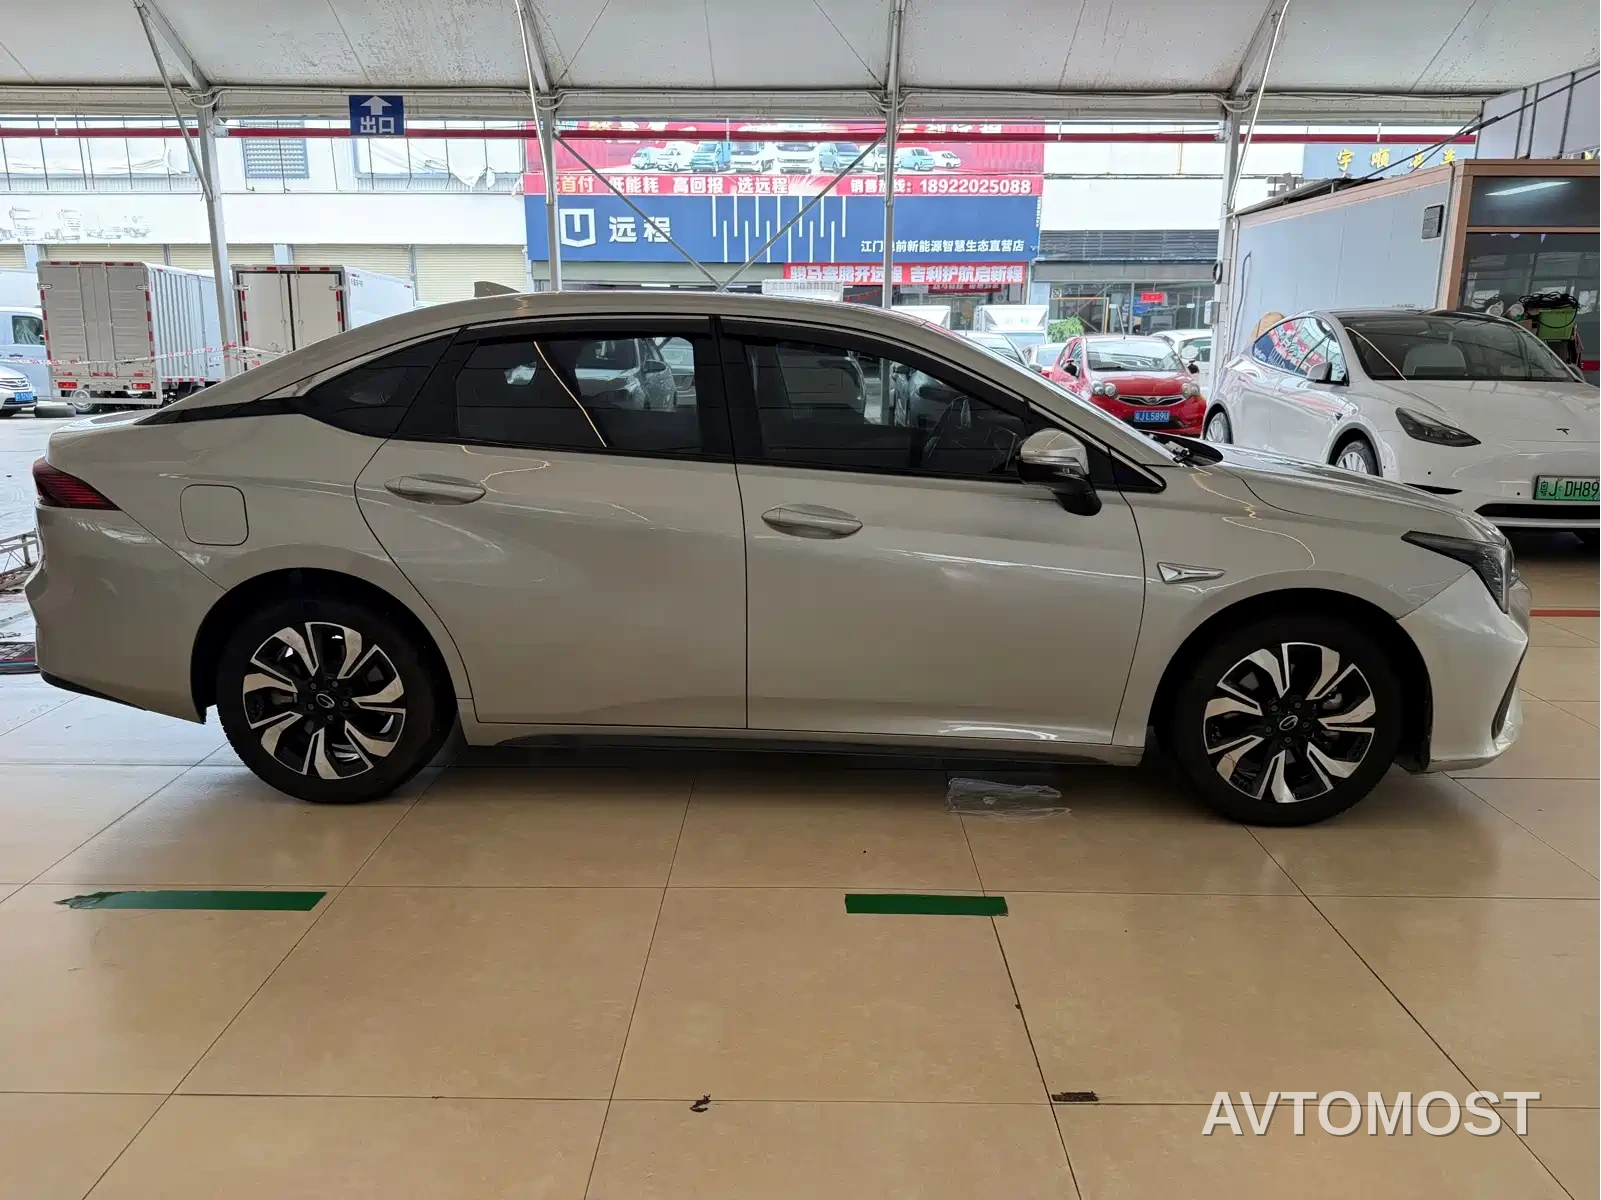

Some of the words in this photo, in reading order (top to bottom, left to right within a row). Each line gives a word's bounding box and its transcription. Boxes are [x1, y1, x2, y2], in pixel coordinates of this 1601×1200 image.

[360, 116, 395, 134] 出口
[608, 175, 660, 194] 低能耗
[672, 176, 724, 195] 高回报
[737, 176, 790, 195] 选远程
[919, 178, 1032, 195] 18922025088
[608, 215, 673, 244] 远程
[860, 239, 1025, 254] 江门前新能源智慧生态直营店
[910, 265, 1023, 283] 吉利护航启新程
